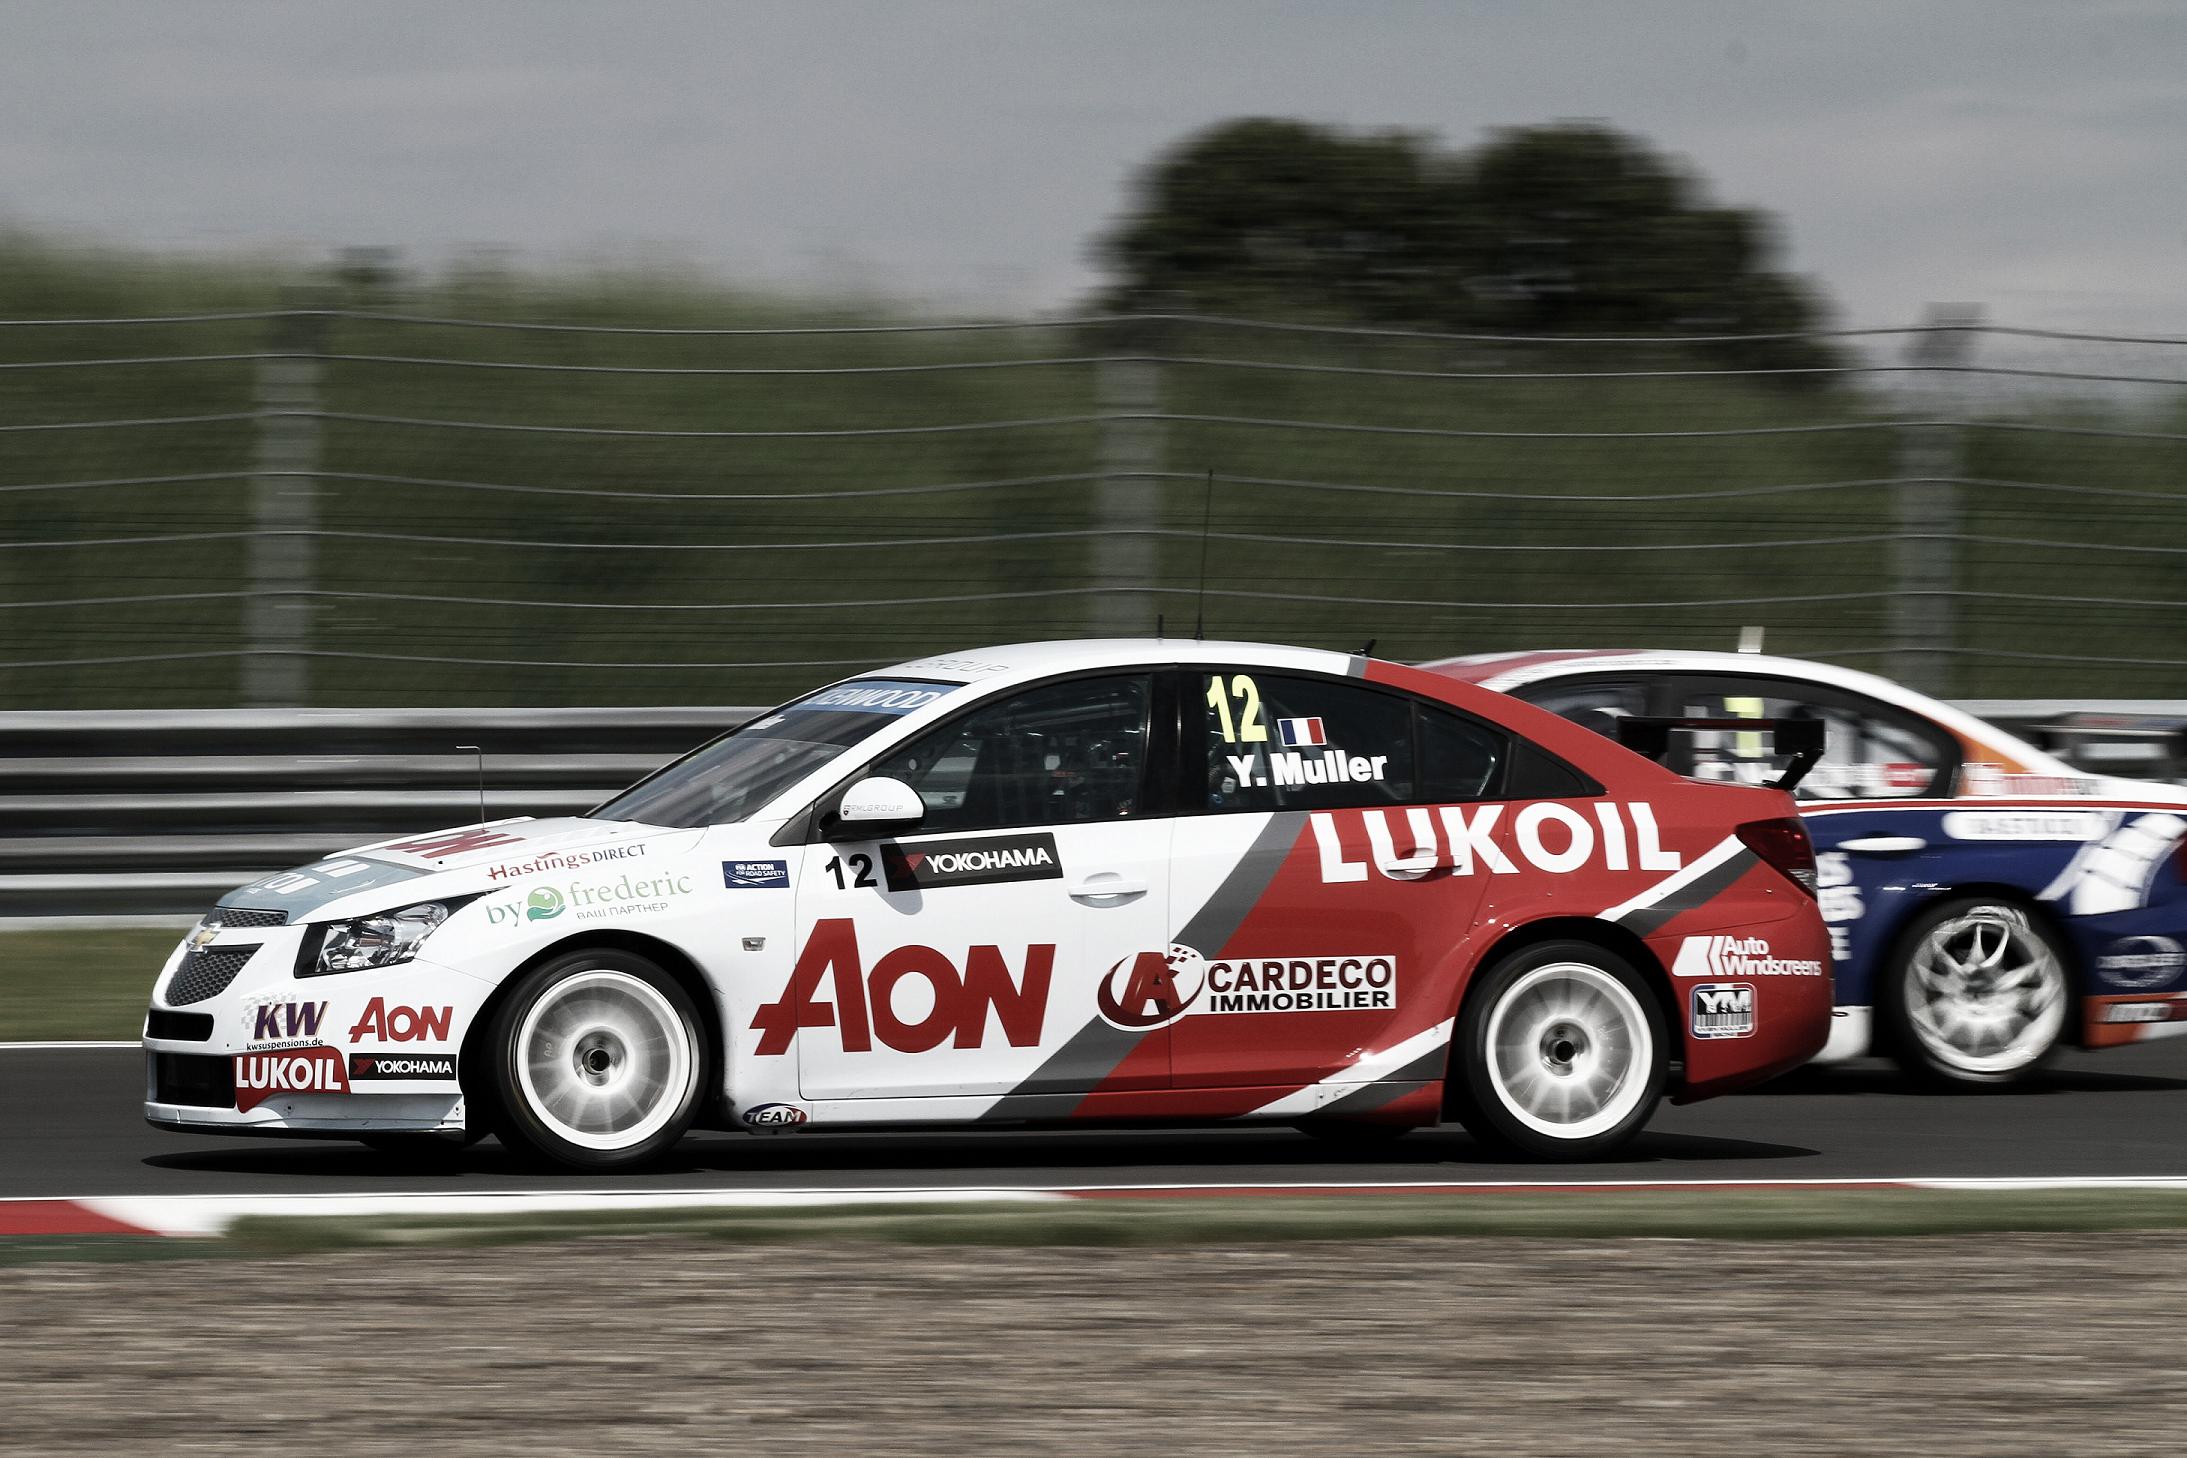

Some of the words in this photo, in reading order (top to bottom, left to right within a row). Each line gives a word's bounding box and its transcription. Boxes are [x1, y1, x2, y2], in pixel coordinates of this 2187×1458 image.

[1207, 675, 1268, 743] 12
[1226, 755, 1268, 787] Y.
[1270, 750, 1388, 786] Muller
[1309, 801, 1682, 883] LUKOIL
[486, 852, 591, 881] Hastings
[592, 843, 646, 863] DIRECT
[747, 863, 775, 871] ACTION
[825, 853, 879, 889] 12
[925, 847, 1053, 873] YOKOHAMA
[486, 902, 522, 927] by
[568, 872, 693, 907] frederic
[1721, 936, 1769, 955] Auto
[1207, 956, 1391, 992] CARDECO
[1722, 955, 1822, 976] Windscreens
[1210, 992, 1390, 1011] IMMOBILIER
[253, 1001, 329, 1040] KW
[246, 1037, 324, 1051] kwsuspensions.de
[236, 1057, 341, 1090] LUKOIL
[375, 1060, 452, 1074] YOKOHAMA
[747, 1111, 802, 1123] TEAM
